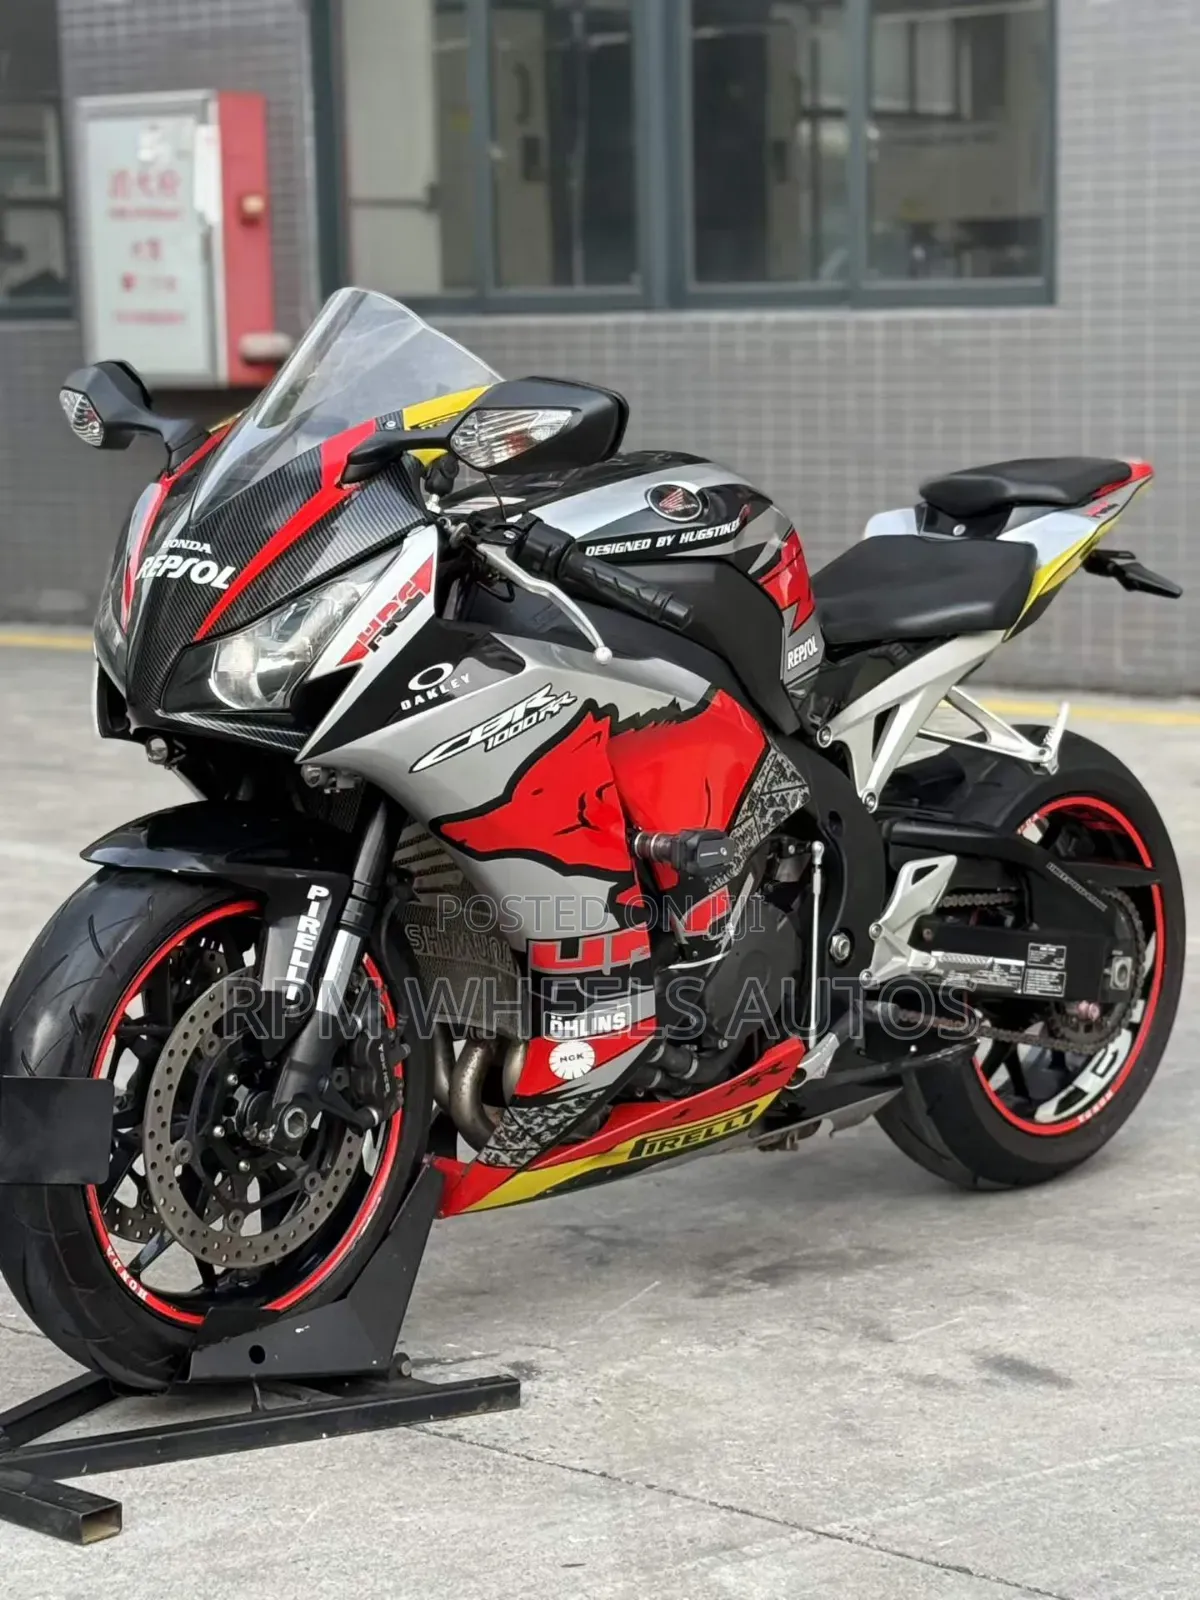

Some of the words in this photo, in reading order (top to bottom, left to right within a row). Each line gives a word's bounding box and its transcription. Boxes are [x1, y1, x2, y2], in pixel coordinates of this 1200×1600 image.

[161, 539, 212, 555] HONDA
[585, 538, 651, 557] DESIGNED
[656, 534, 676, 548] BY
[135, 554, 236, 590] REPSOL
[787, 635, 819, 671] REPSOL
[400, 672, 472, 711] OAKLEY
[408, 682, 556, 773] CBR
[286, 884, 330, 1001] PIRELLI
[550, 1010, 626, 1038] ÖHLINS
[559, 1052, 584, 1063] NGK
[627, 1103, 759, 1160] PIRELLI
